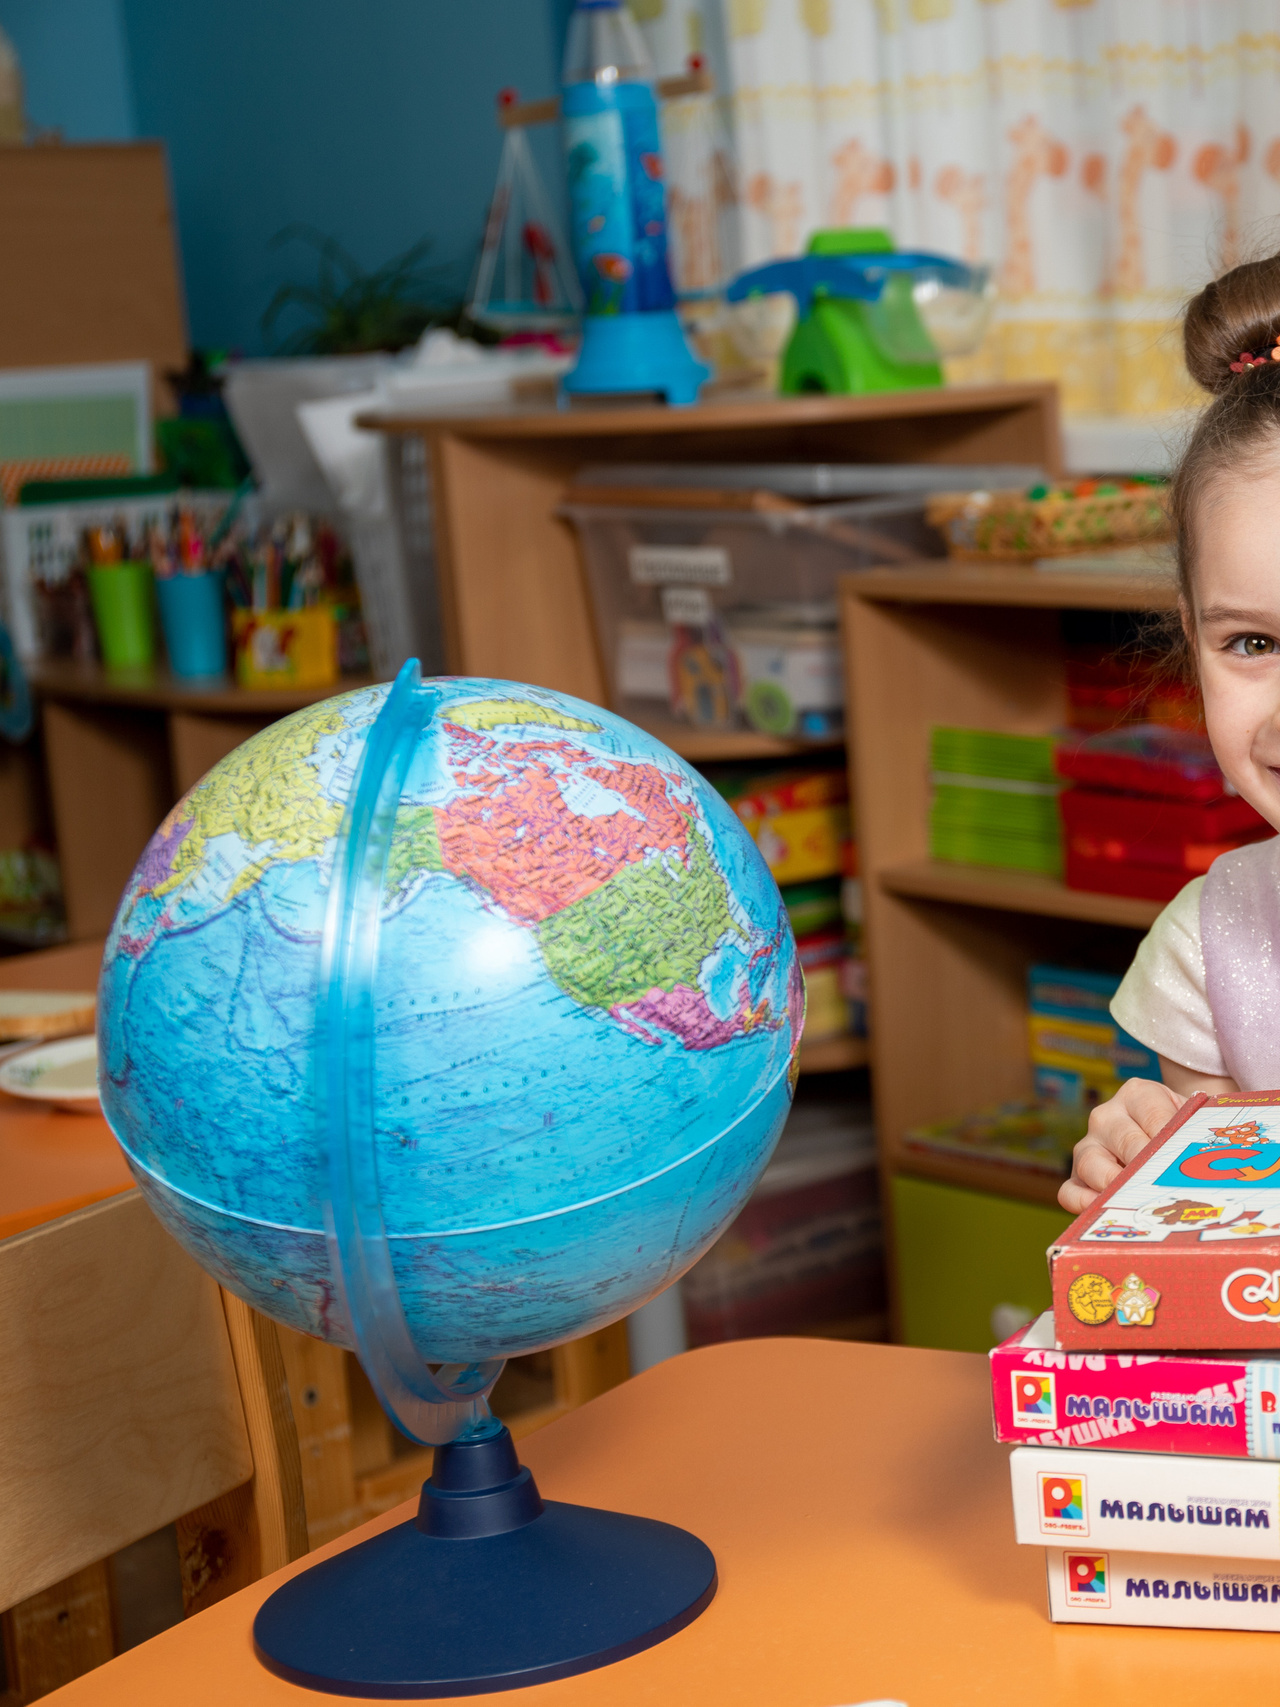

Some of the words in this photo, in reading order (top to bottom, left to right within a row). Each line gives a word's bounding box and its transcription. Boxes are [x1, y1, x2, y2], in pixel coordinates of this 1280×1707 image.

[1066, 1395, 1236, 1427] МАЛЫШАМ
[1260, 1390, 1277, 1413] В
[1100, 1498, 1270, 1529] МАЛЫШАМ
